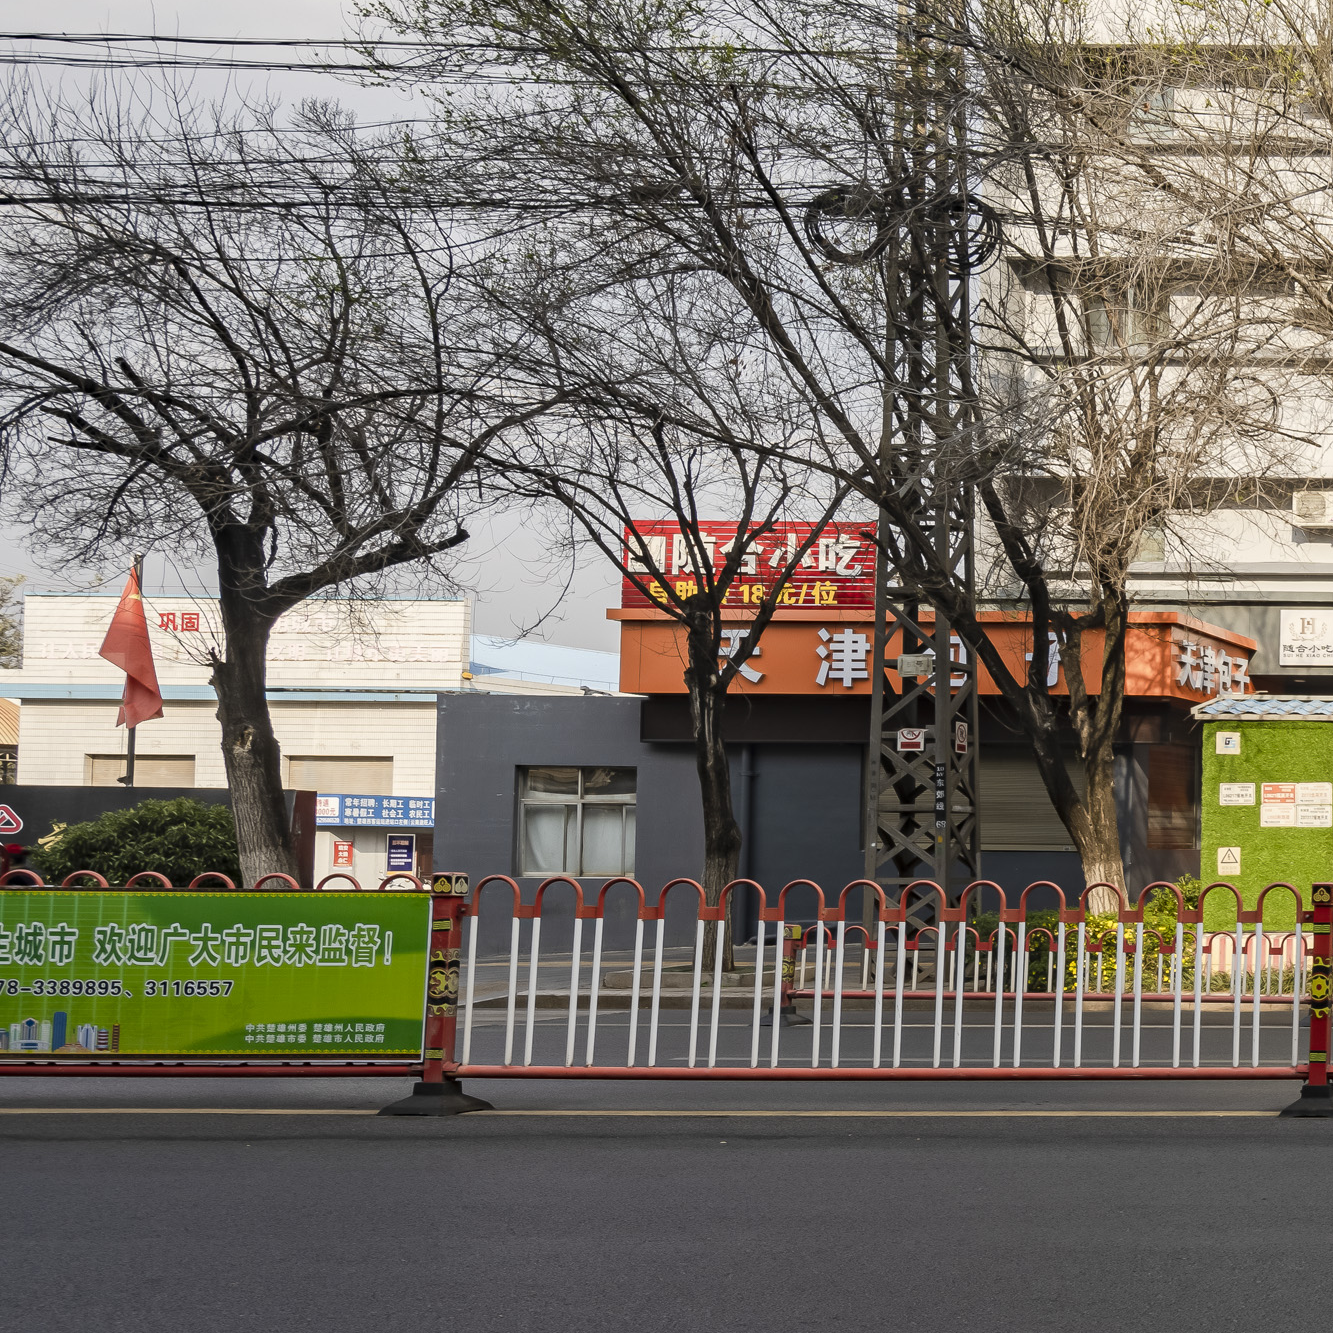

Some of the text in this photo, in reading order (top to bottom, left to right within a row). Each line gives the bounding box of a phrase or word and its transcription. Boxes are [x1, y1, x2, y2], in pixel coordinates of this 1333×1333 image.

[158, 612, 200, 632] 巩固
[1282, 644, 1333, 653] 随合小吃
[1176, 640, 1250, 695] 天津包子
[93, 922, 393, 967] 欢迎广大市民来监督！
[245, 1023, 386, 1033] 中共楚雄州委 楚雄州人民政府
[244, 1034, 385, 1044] 中共楚雄市委 楚雄市人民政府
